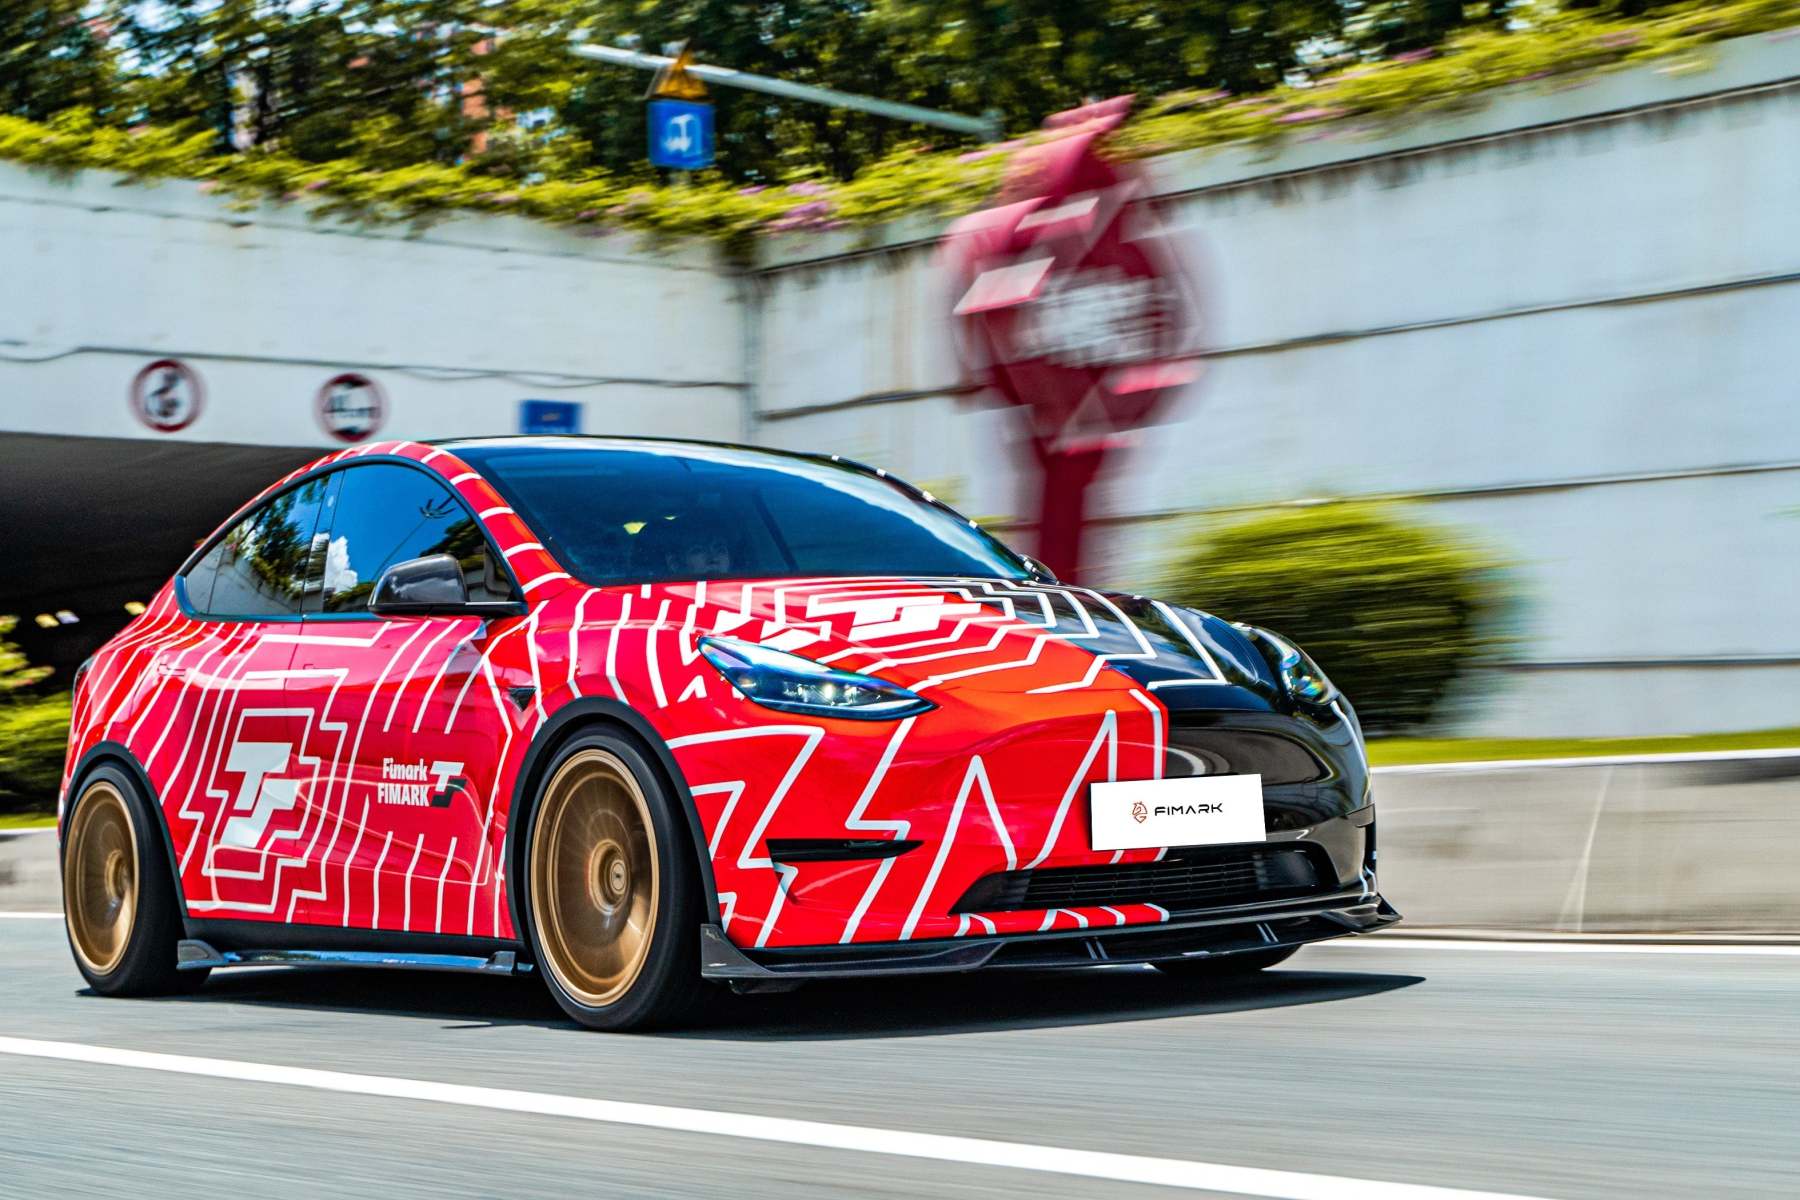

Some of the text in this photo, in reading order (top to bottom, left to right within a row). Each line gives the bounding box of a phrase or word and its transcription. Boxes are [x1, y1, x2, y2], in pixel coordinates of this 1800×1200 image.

[382, 757, 428, 781] Fimark
[377, 782, 430, 807] FIMARK
[1154, 802, 1223, 817] FIMARK
